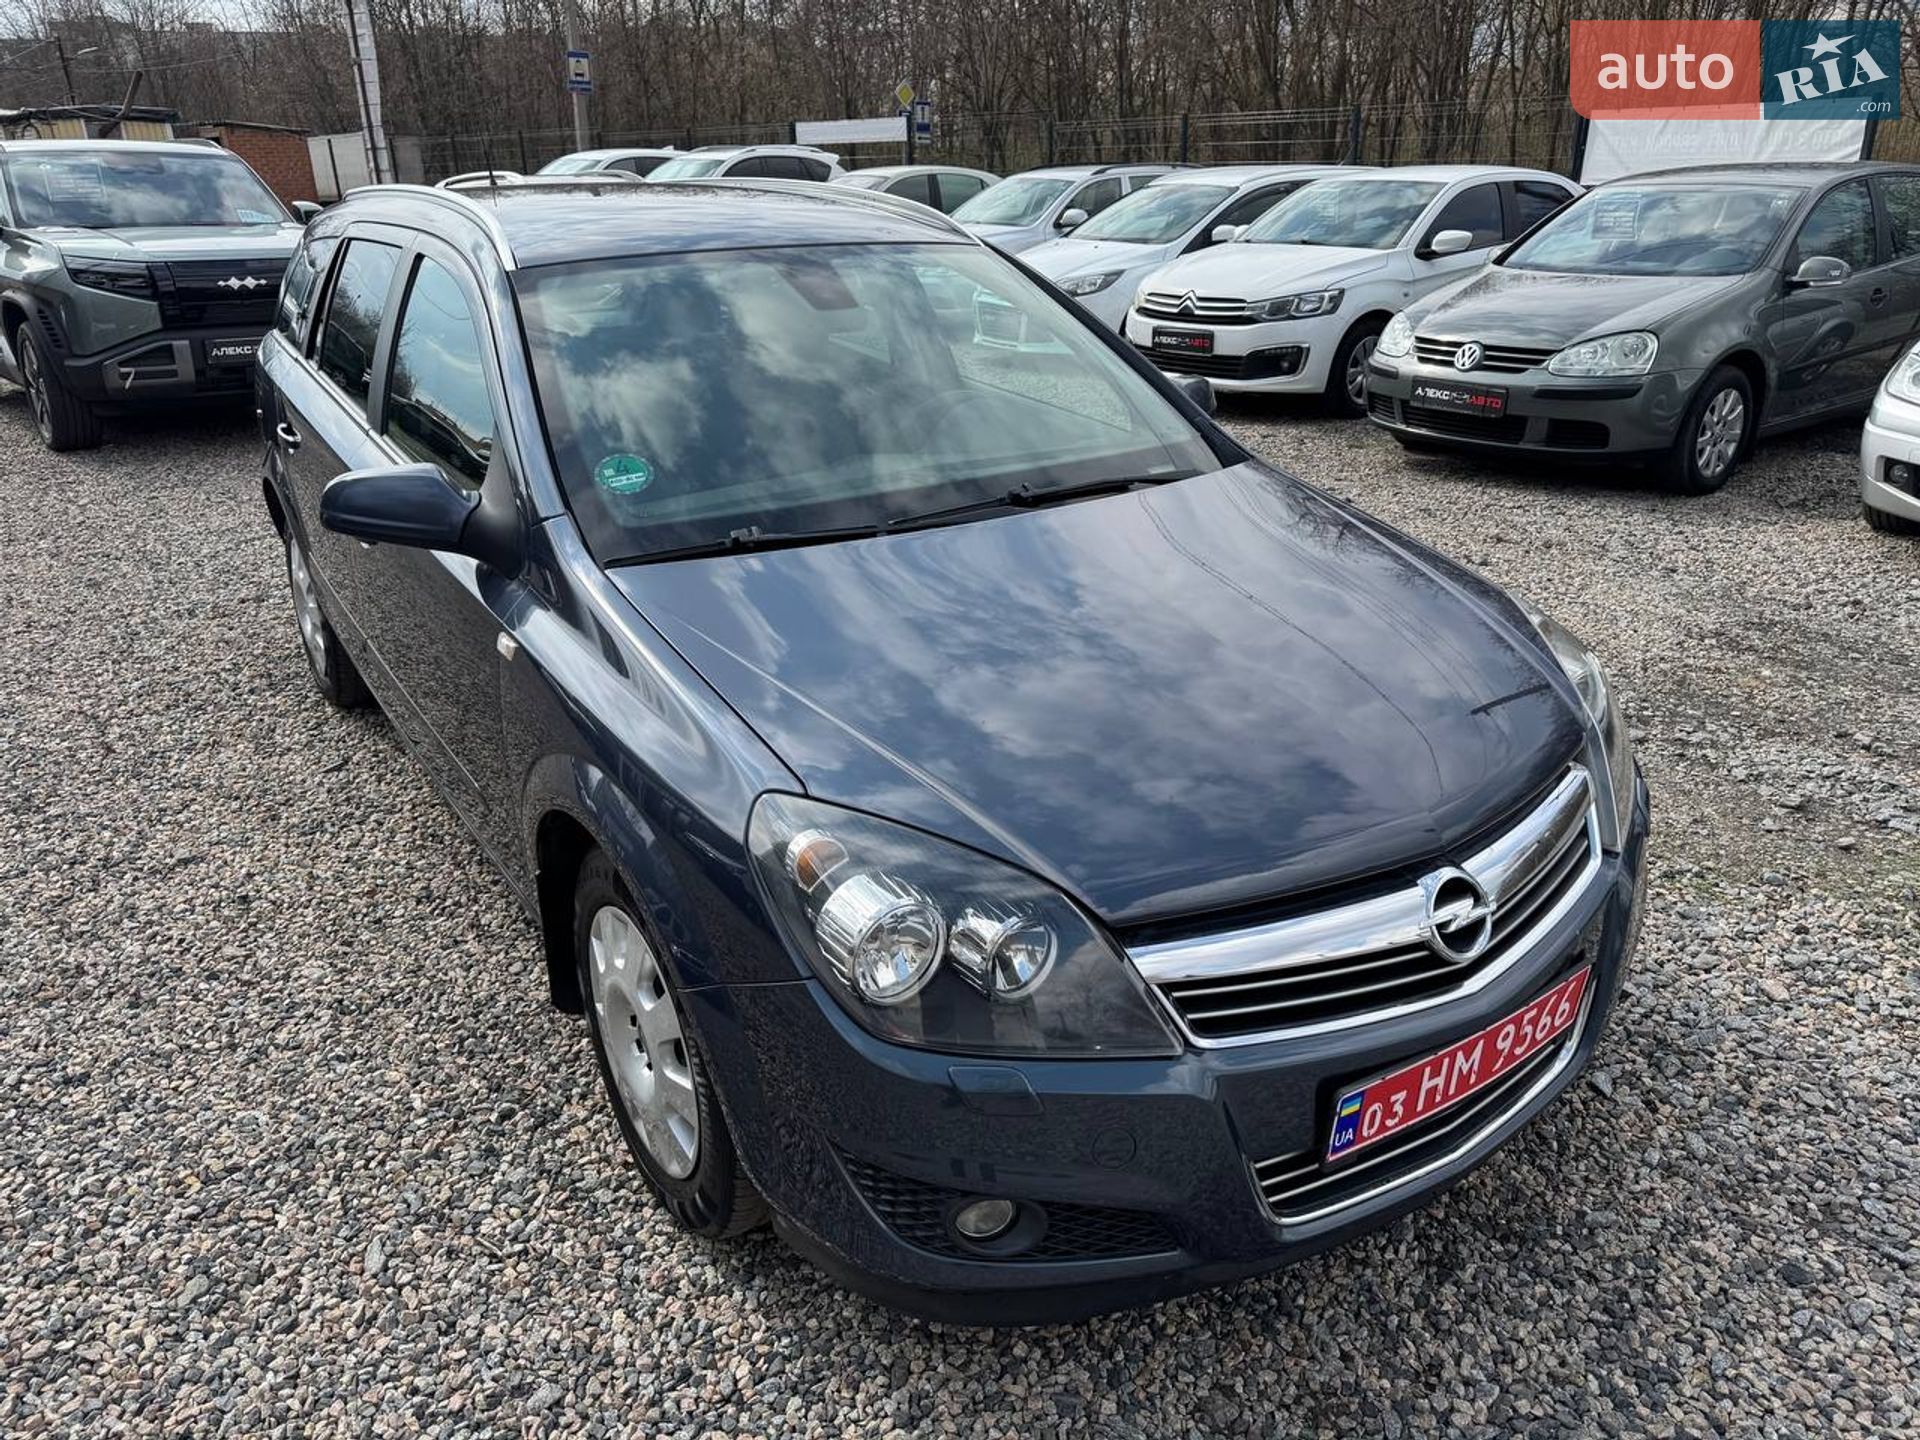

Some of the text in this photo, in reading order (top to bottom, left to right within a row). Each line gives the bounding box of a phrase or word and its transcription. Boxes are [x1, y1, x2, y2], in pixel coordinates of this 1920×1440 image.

[1361, 1090, 1407, 1138] 03
[1493, 981, 1578, 1072] 9566
[1334, 1129, 1355, 1147] UA
